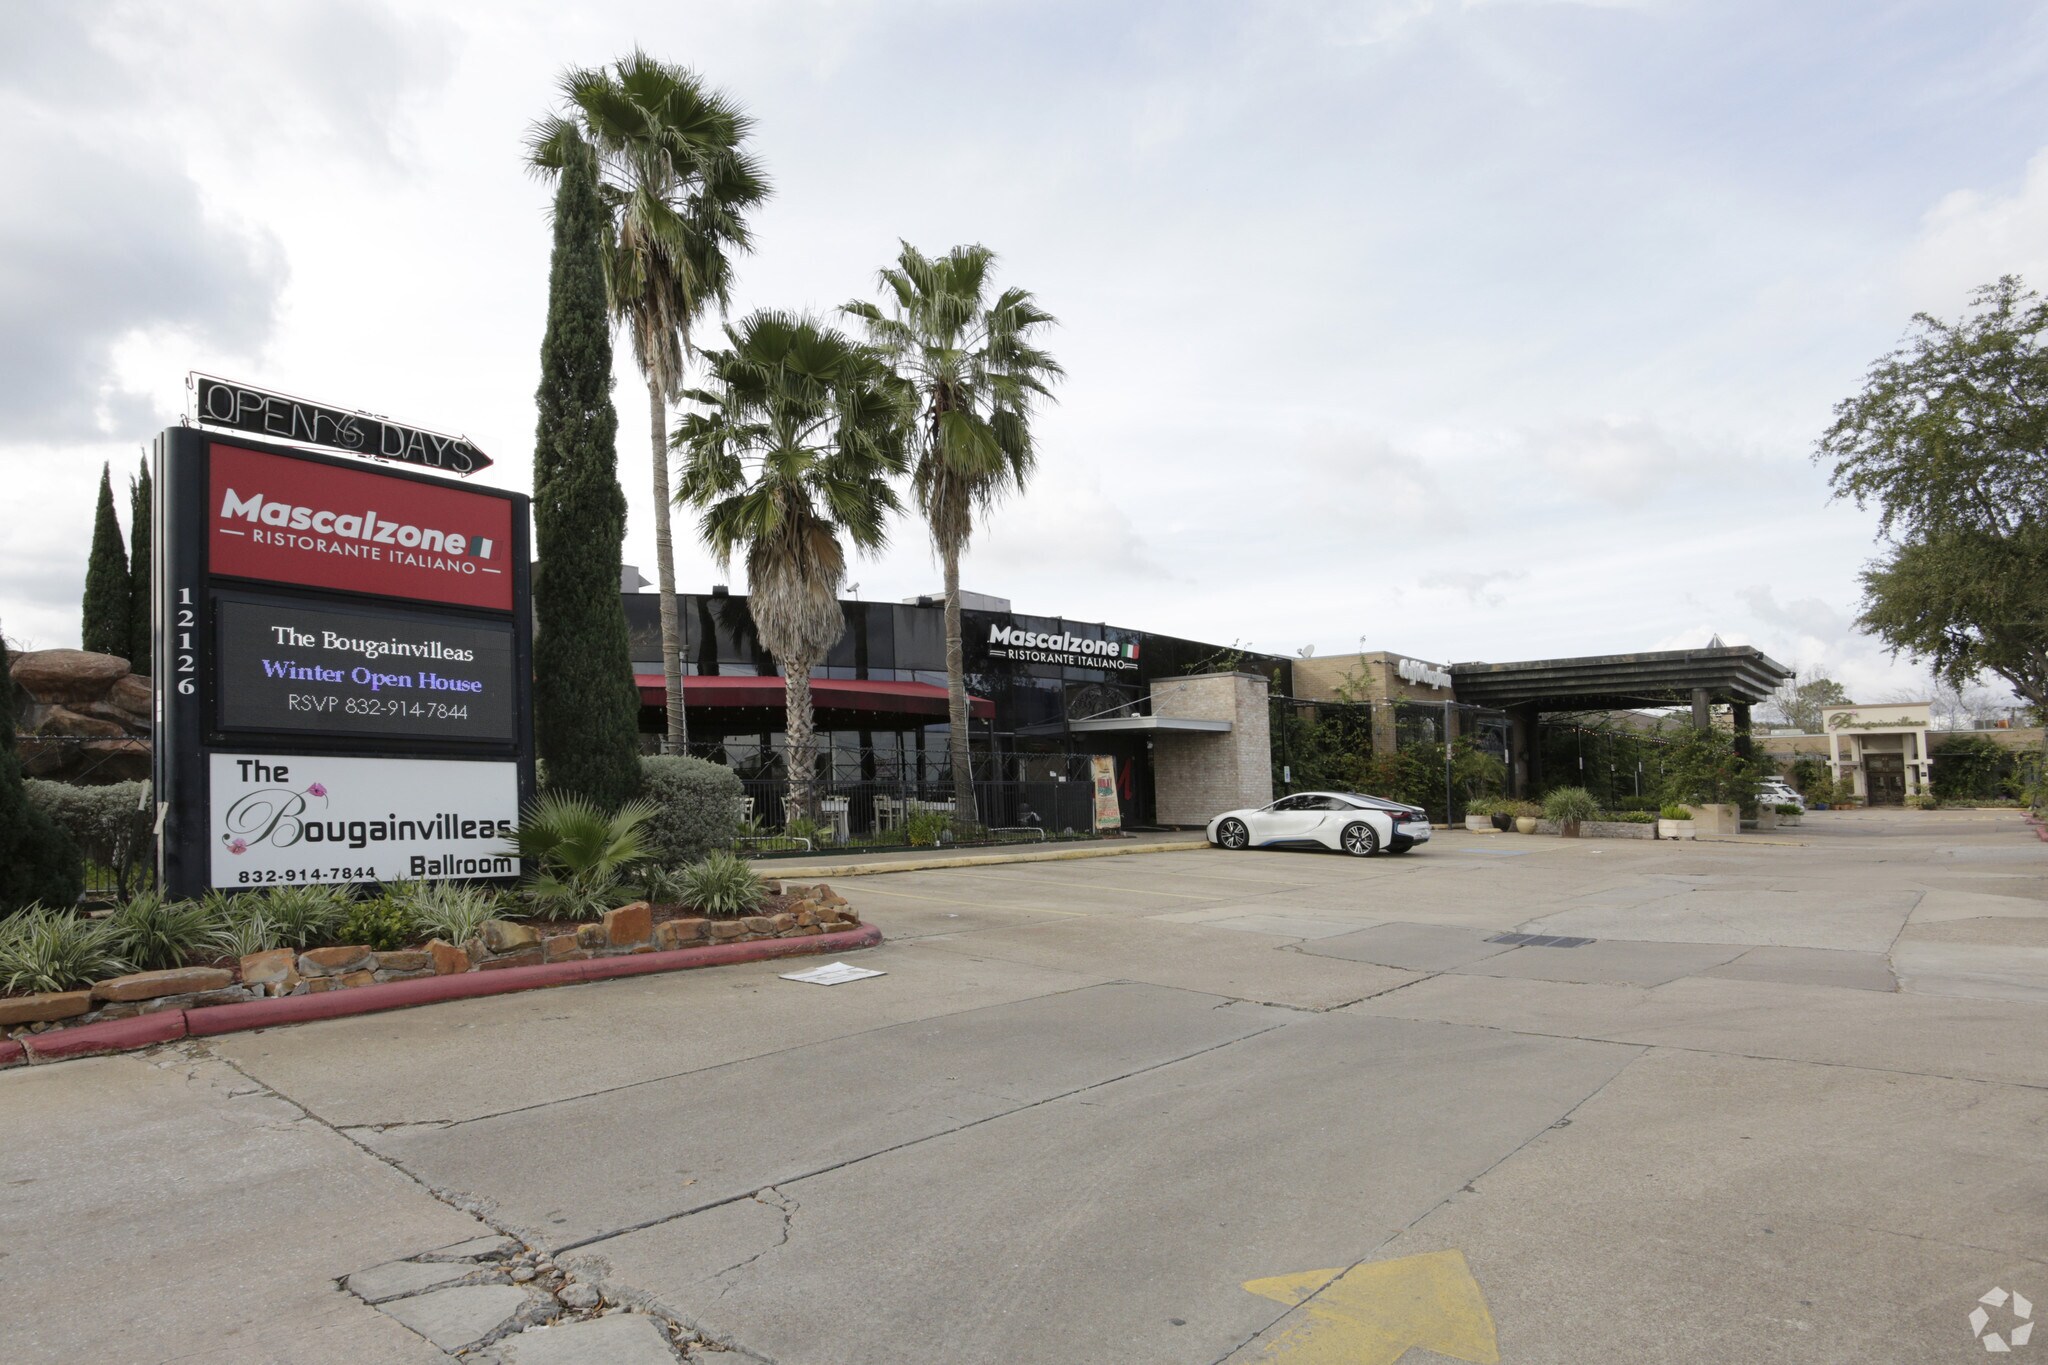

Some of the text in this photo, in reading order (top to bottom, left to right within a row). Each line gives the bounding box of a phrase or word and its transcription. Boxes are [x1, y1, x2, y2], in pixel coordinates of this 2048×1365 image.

[206, 384, 473, 473] OPEN 6 DAYS
[220, 488, 466, 555] Mascalzone
[253, 529, 476, 575] RISTORANTE ITALIANO
[271, 626, 474, 661] The Bougainvilleas
[990, 624, 1120, 657] Mascalzone
[262, 659, 483, 693] Winter Open House
[1008, 649, 1125, 670] RISTORANTE ITALIANO
[289, 694, 468, 720] RSVP 832-914-7844
[236, 759, 290, 783] The
[223, 788, 512, 848] Bougainvilleas
[238, 854, 512, 884] 832-914-7844 Ballroom
